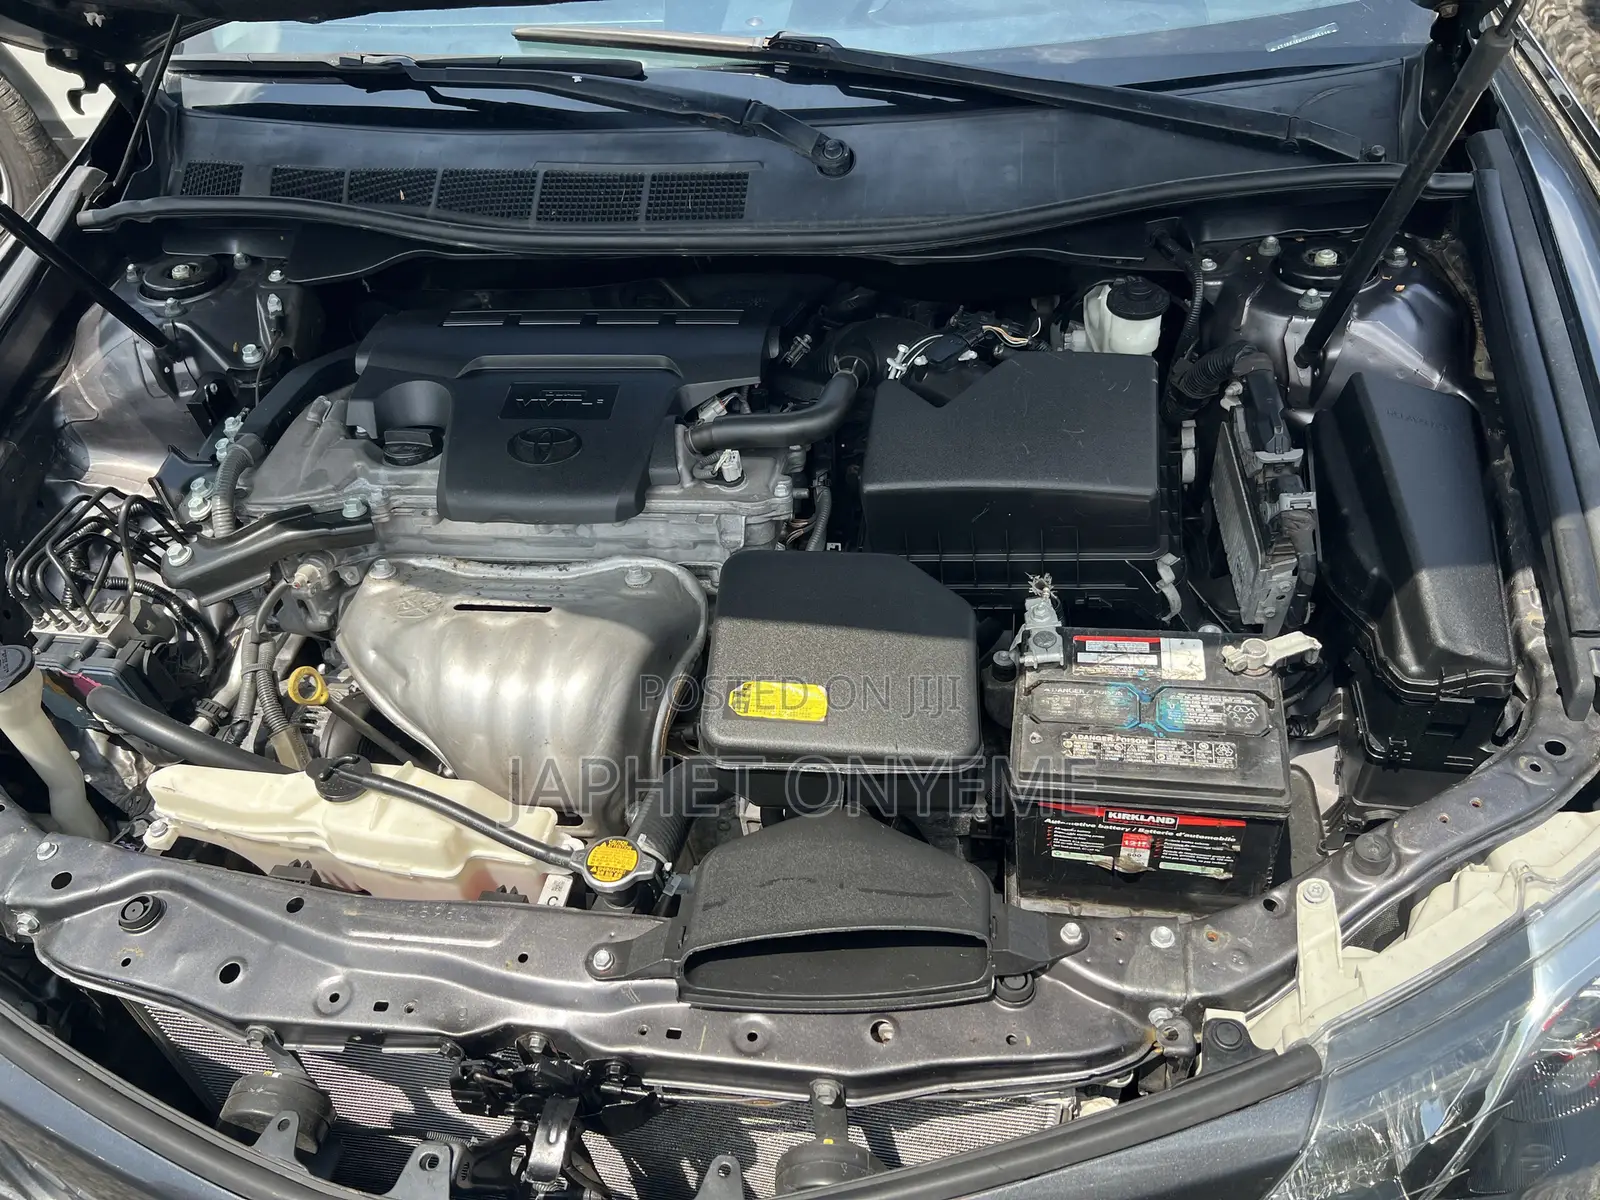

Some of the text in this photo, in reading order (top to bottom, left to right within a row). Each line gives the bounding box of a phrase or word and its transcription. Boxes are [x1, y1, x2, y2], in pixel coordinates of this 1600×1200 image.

[1116, 735, 1149, 745] POISON
[1108, 811, 1176, 825] KIRKLAND
[1098, 823, 1131, 833] battery
[1137, 827, 1174, 837] Batterie
